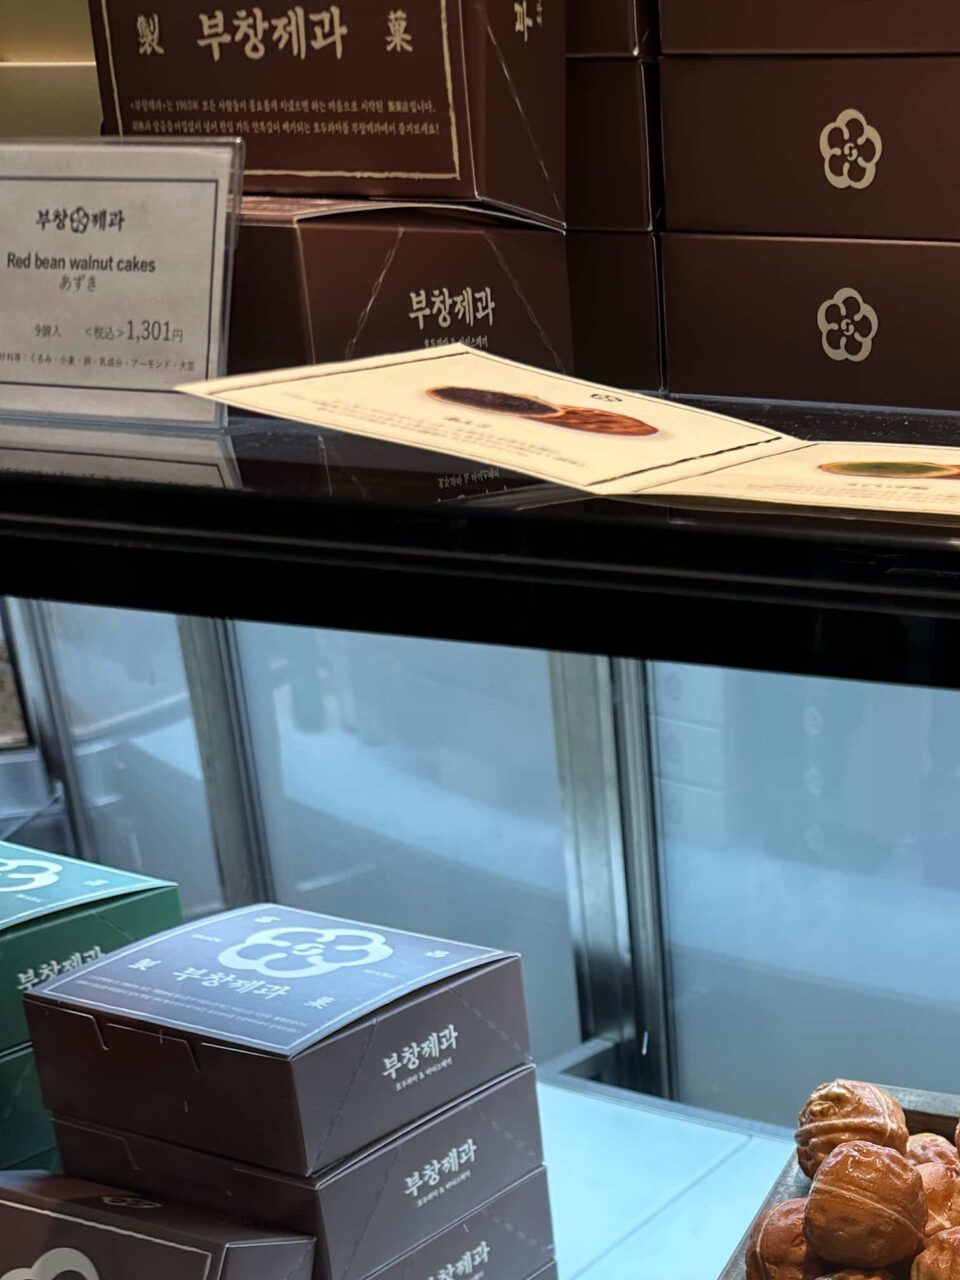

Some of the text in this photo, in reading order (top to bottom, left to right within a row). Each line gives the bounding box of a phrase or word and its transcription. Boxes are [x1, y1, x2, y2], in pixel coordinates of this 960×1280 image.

[196, 5, 348, 62] 부창제과
[7, 252, 156, 273] Red bean walnut cakes
[59, 274, 97, 292] あずき
[409, 286, 495, 330] 부창제과
[173, 966, 291, 1001] 부창제과
[382, 1024, 459, 1079] 부창제과
[404, 1138, 477, 1197] 부창제과
